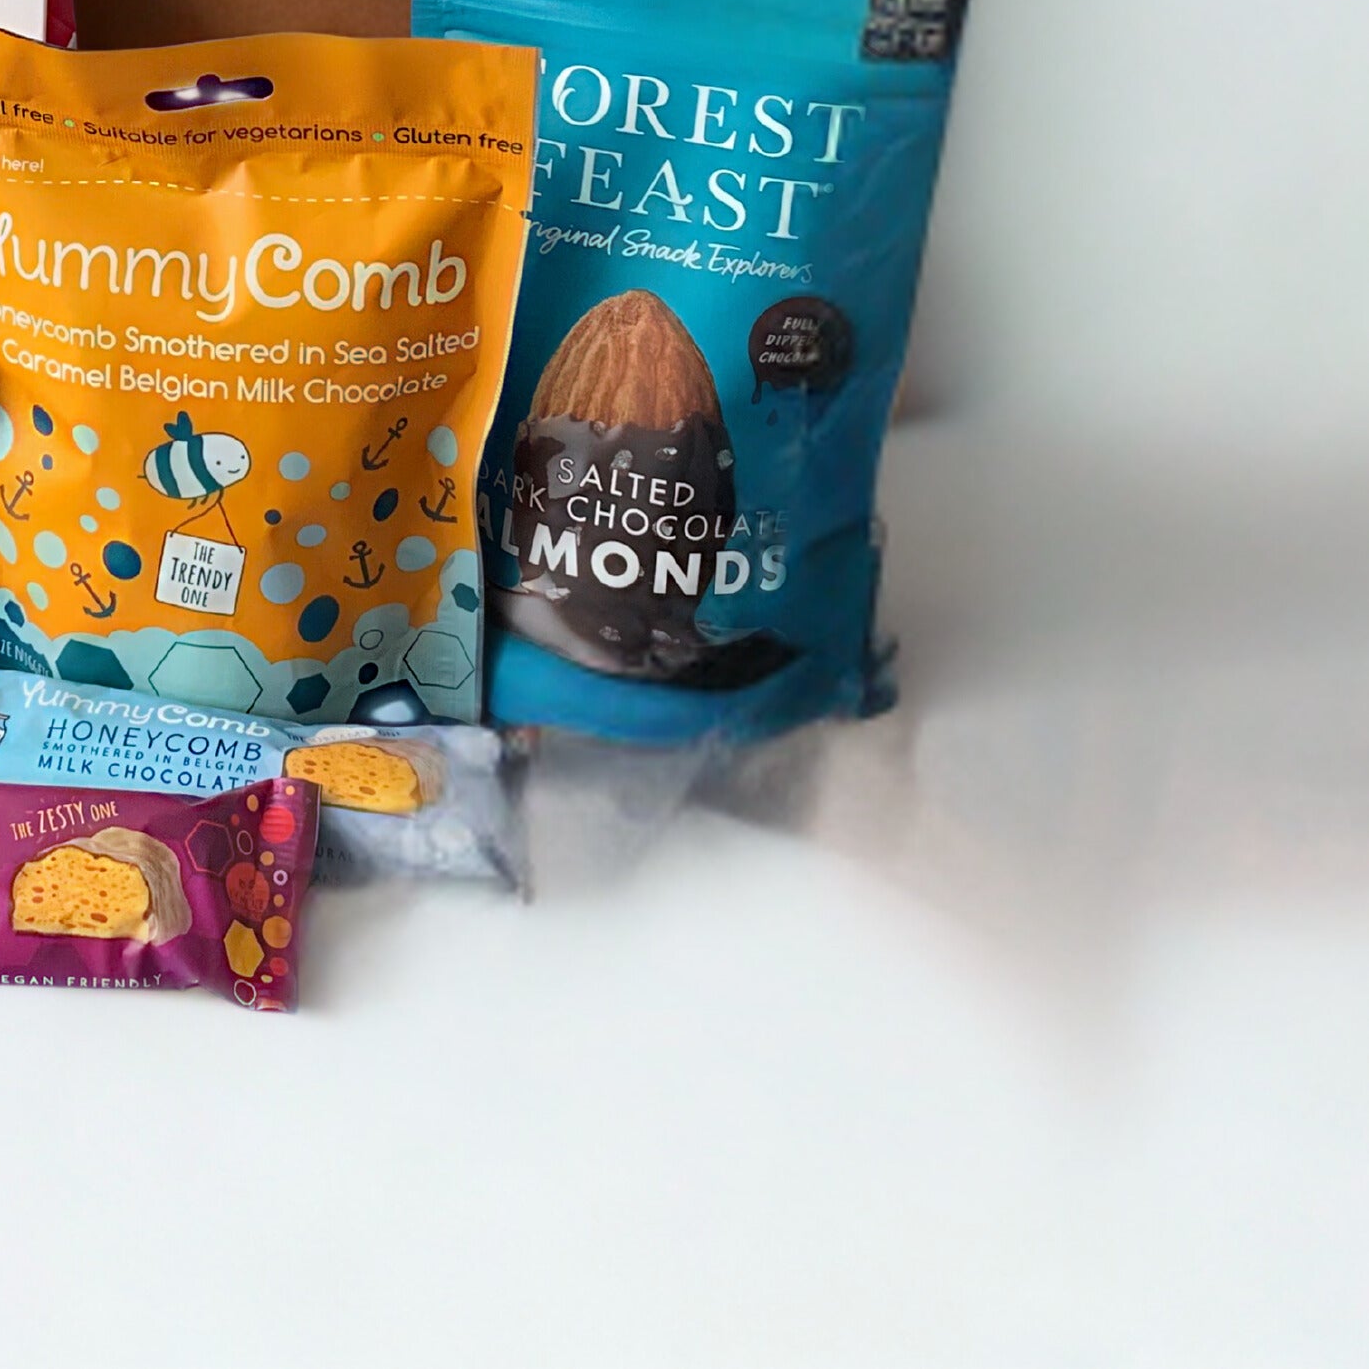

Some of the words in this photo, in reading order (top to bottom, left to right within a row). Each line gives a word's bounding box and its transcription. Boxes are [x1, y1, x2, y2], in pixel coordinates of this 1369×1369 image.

[13, 103, 54, 125] free
[83, 121, 178, 145] Suitable
[184, 129, 218, 145] for
[223, 124, 363, 143] vegetarians
[393, 127, 472, 146] Gluten
[479, 133, 524, 155] free
[540, 58, 866, 165] OREST
[1, 155, 44, 173] here!
[533, 137, 821, 241] FEAST
[528, 219, 621, 255] riginal
[621, 229, 703, 270] Snack
[708, 242, 814, 284] Explorers
[124, 326, 290, 365] Smothered
[298, 341, 325, 365] in
[333, 339, 387, 366] Sea
[396, 326, 480, 363] Salted
[2, 338, 113, 390] Caramel
[119, 364, 228, 402] Belgian
[237, 375, 296, 403] Milk
[303, 369, 448, 404] Chocolate
[557, 458, 695, 508] SALTED
[566, 495, 792, 542] CHOCOLATE
[193, 542, 215, 564] THE
[478, 491, 788, 597] ALMONDS
[171, 557, 233, 591] TRENDY
[181, 586, 209, 608] ONE
[21, 679, 271, 738] YummyComb
[42, 741, 146, 761] SMOTHERED
[155, 753, 172, 764] IN
[183, 755, 258, 776] BELGIAN
[47, 719, 262, 762] HONEYCOMB
[38, 754, 101, 775] MILK
[10, 822, 34, 841] THE
[36, 800, 87, 833] ZESTY
[90, 800, 119, 822] ONE
[67, 973, 162, 989] FRIENDLY
